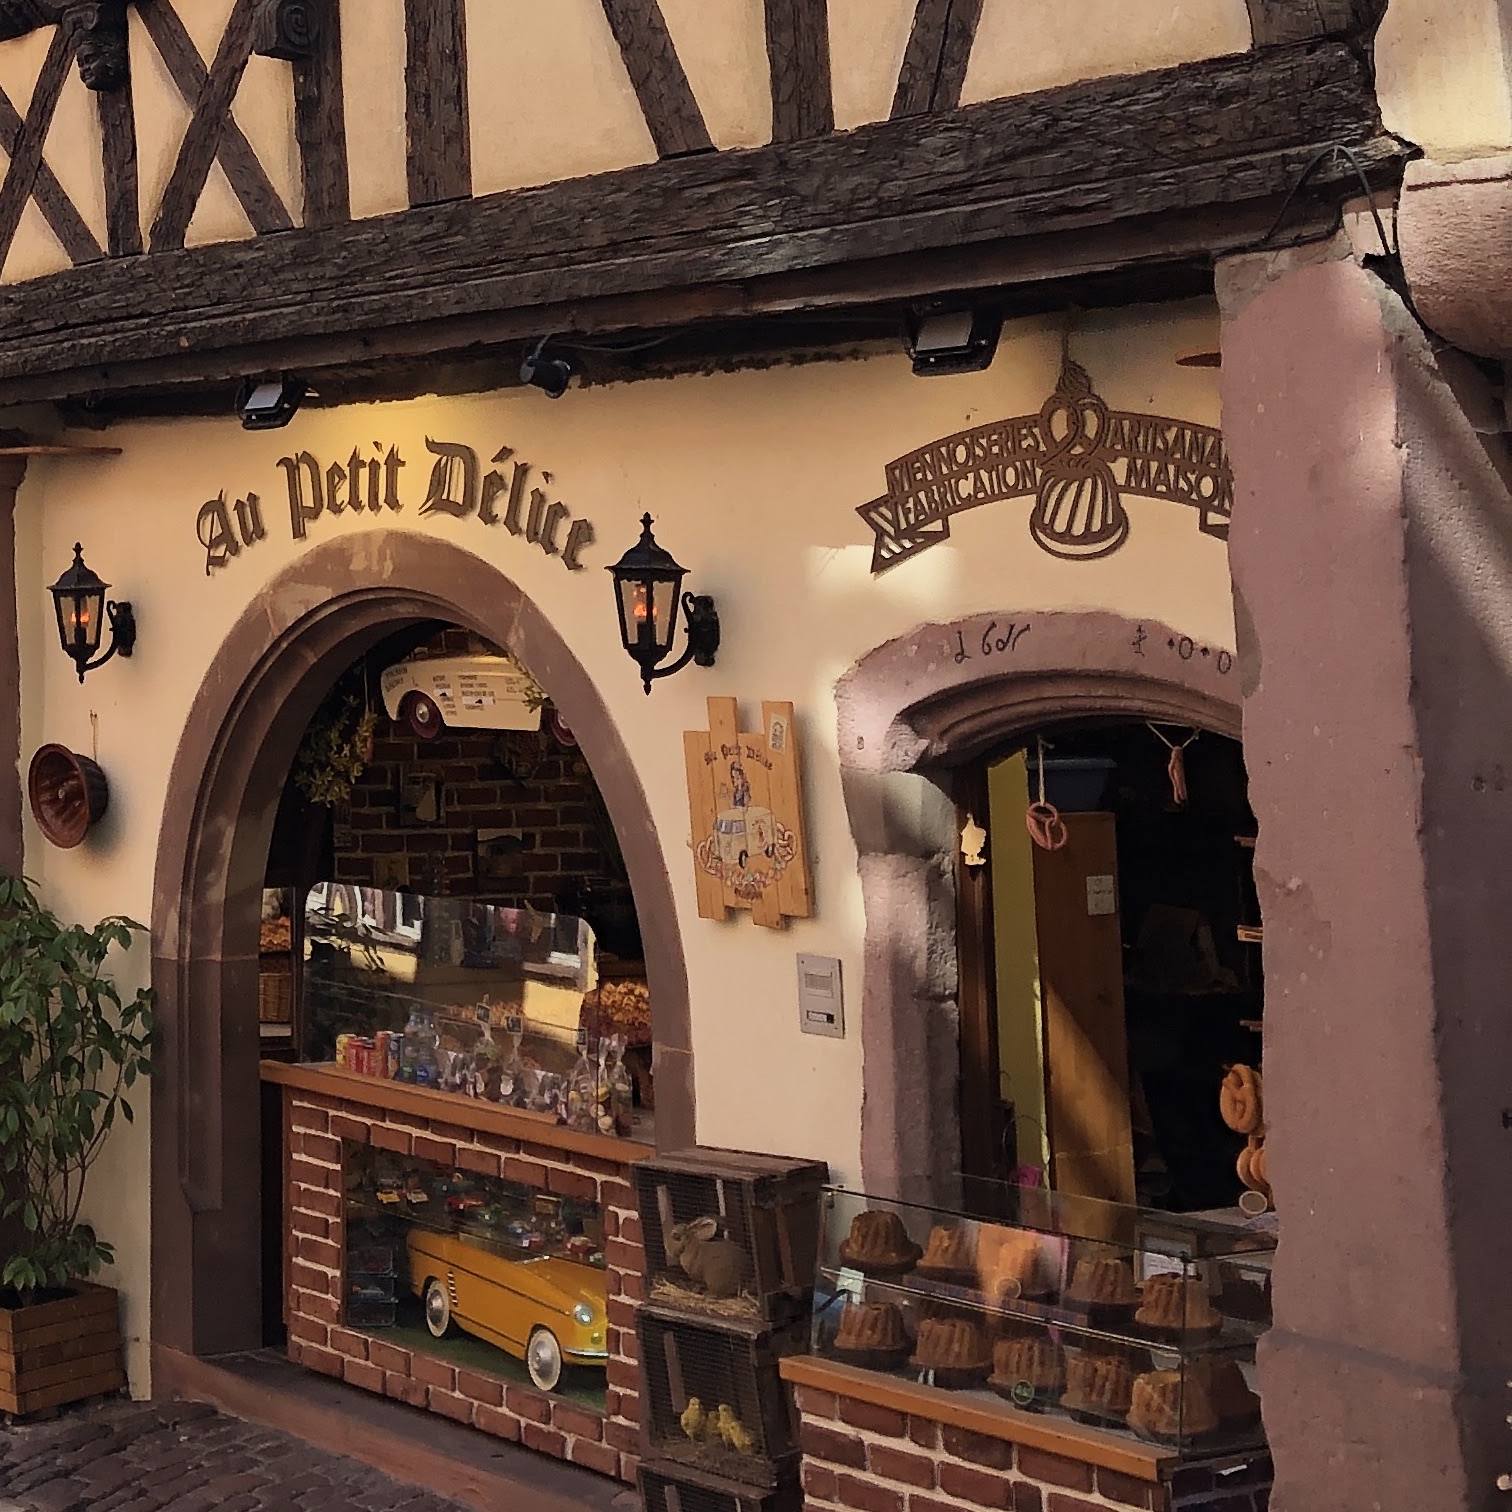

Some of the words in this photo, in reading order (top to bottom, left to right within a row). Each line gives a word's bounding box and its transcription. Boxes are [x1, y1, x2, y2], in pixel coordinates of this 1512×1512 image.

[1104, 417, 1229, 473] ARTISANA
[195, 489, 267, 576] Au
[418, 435, 596, 571] Délice
[897, 458, 1040, 530] FABRICATION
